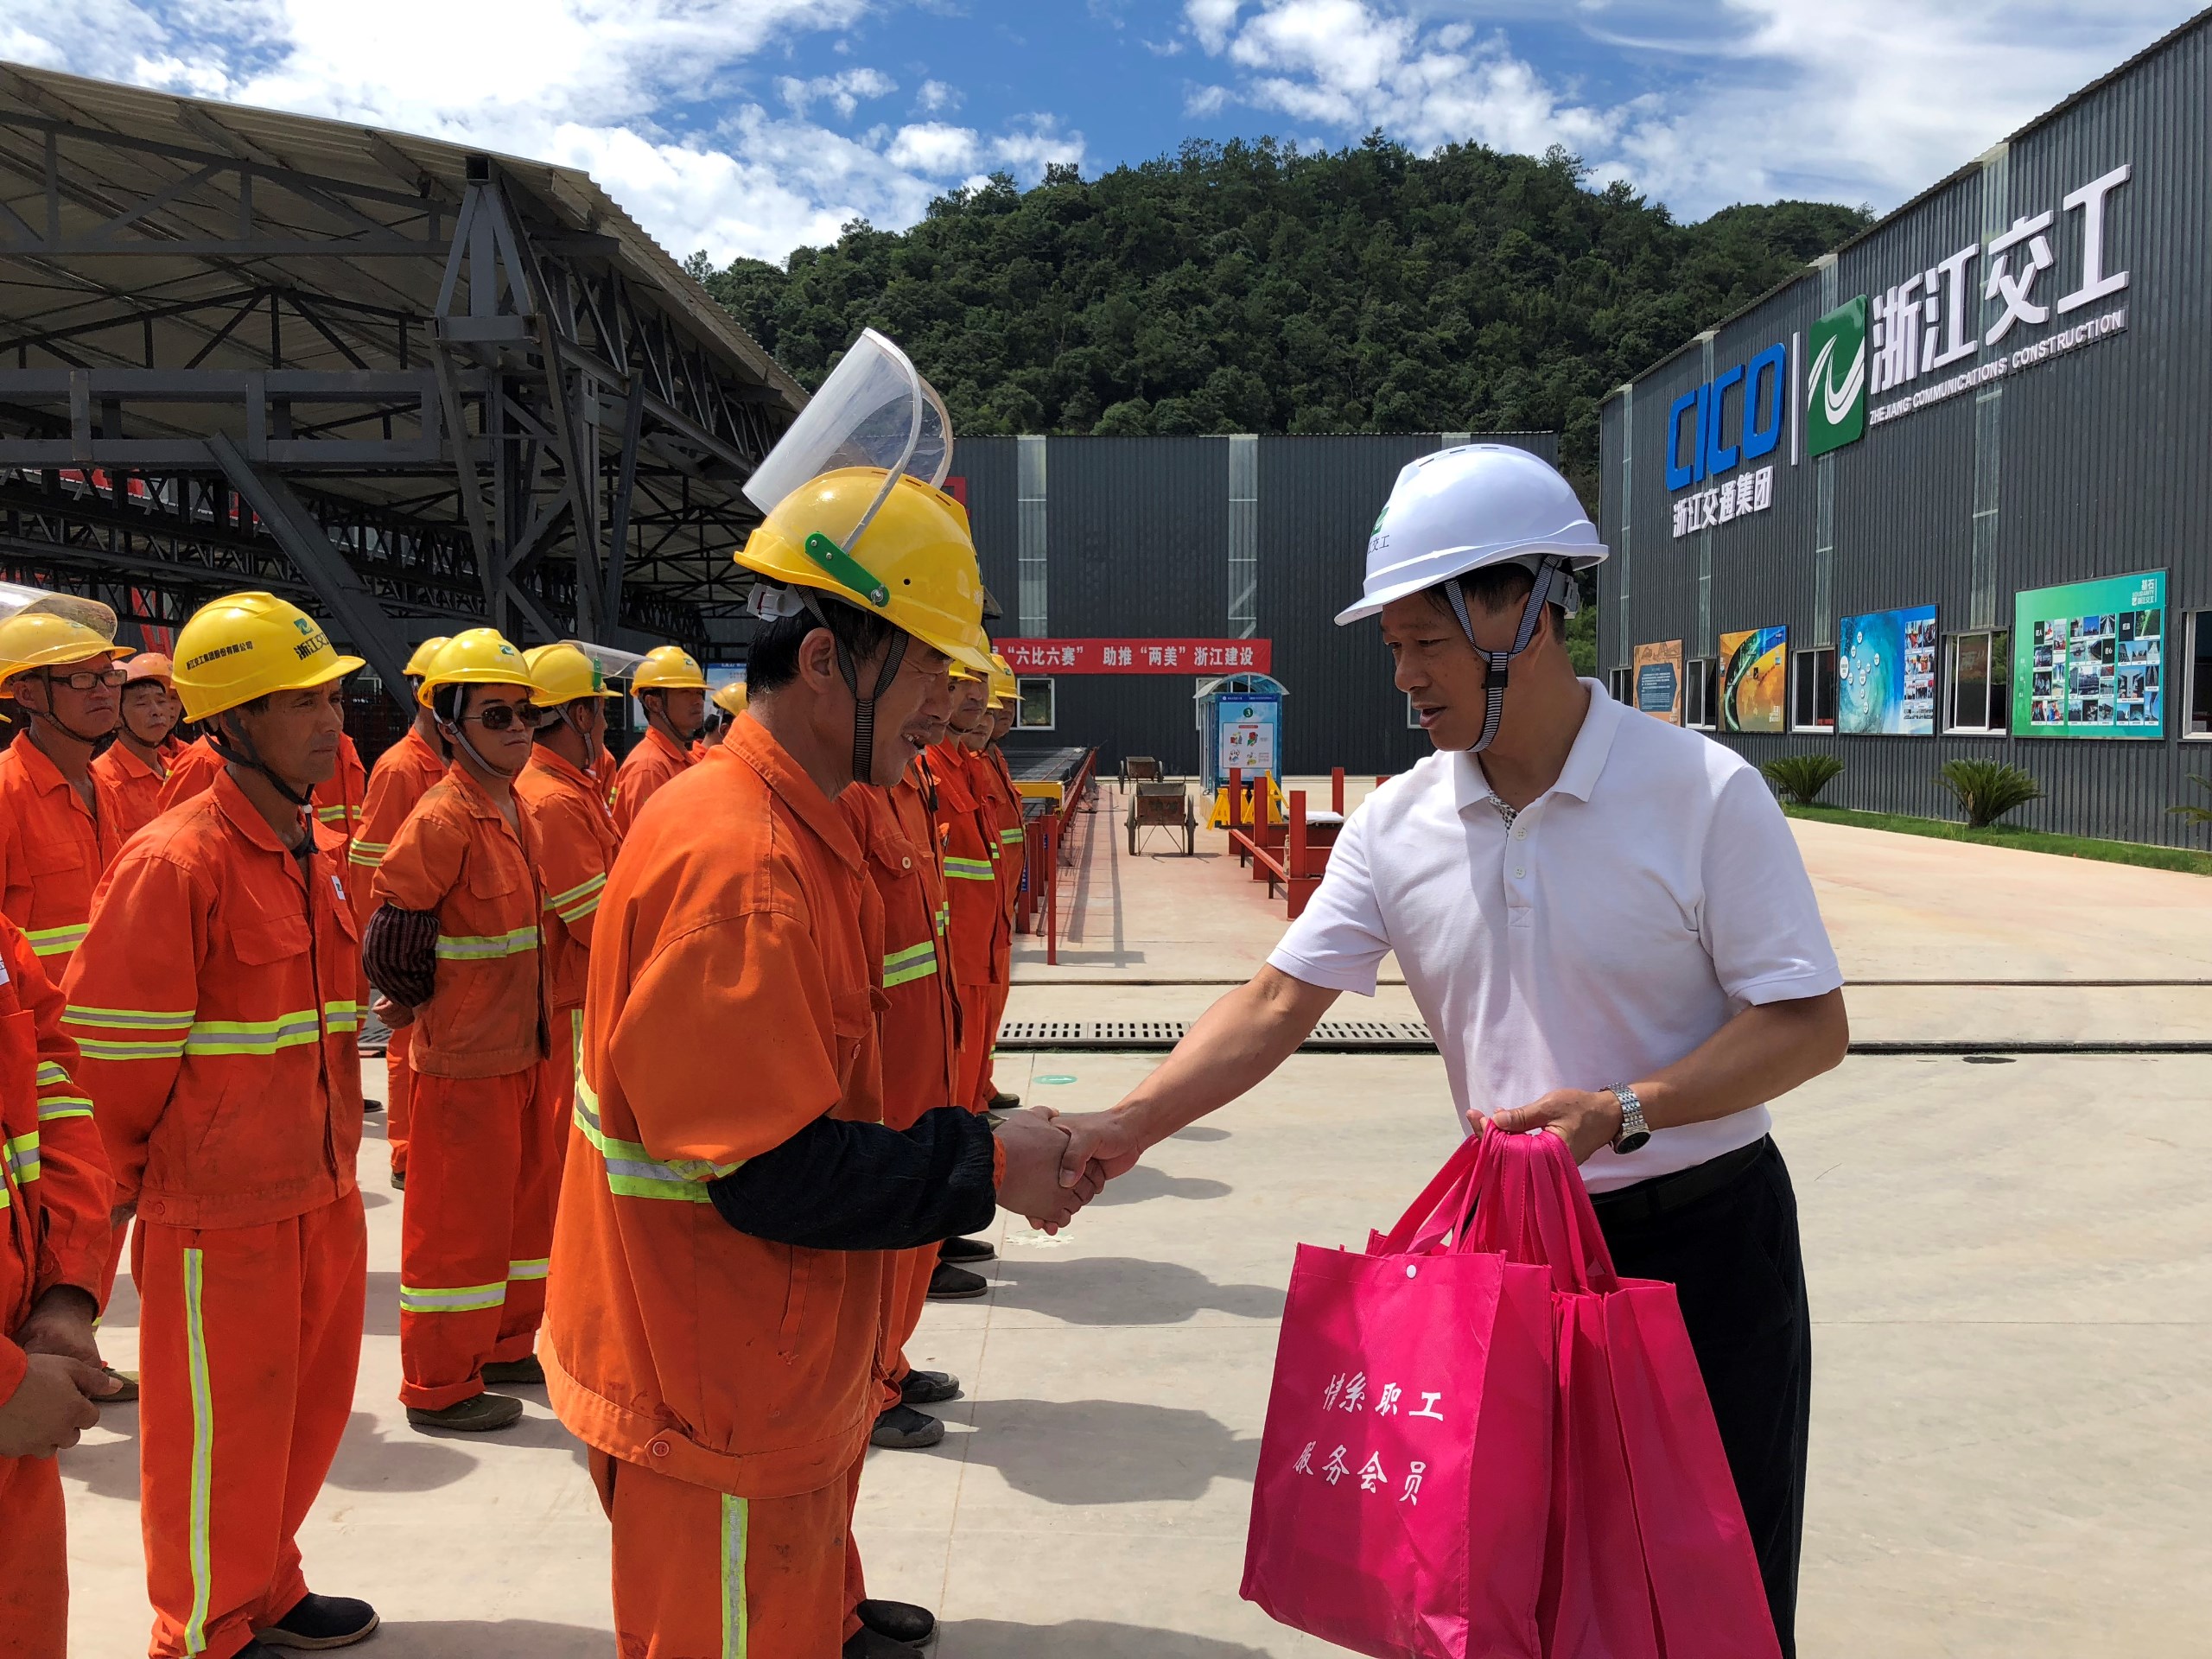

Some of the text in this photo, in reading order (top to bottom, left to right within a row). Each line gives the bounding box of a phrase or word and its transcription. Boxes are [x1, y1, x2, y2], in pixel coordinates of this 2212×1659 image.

[1871, 164, 2131, 395] 浙江交工
[1869, 308, 2126, 426] ZHEJIANG COMMUNICATIONS CONSTRUCTION
[1666, 342, 1787, 492] CICO
[1673, 466, 1774, 537] 浙江交通集团
[1245, 709, 1251, 717] 3
[1323, 1370, 1444, 1421] 情系职工
[1293, 1440, 1427, 1506] 服务会员
